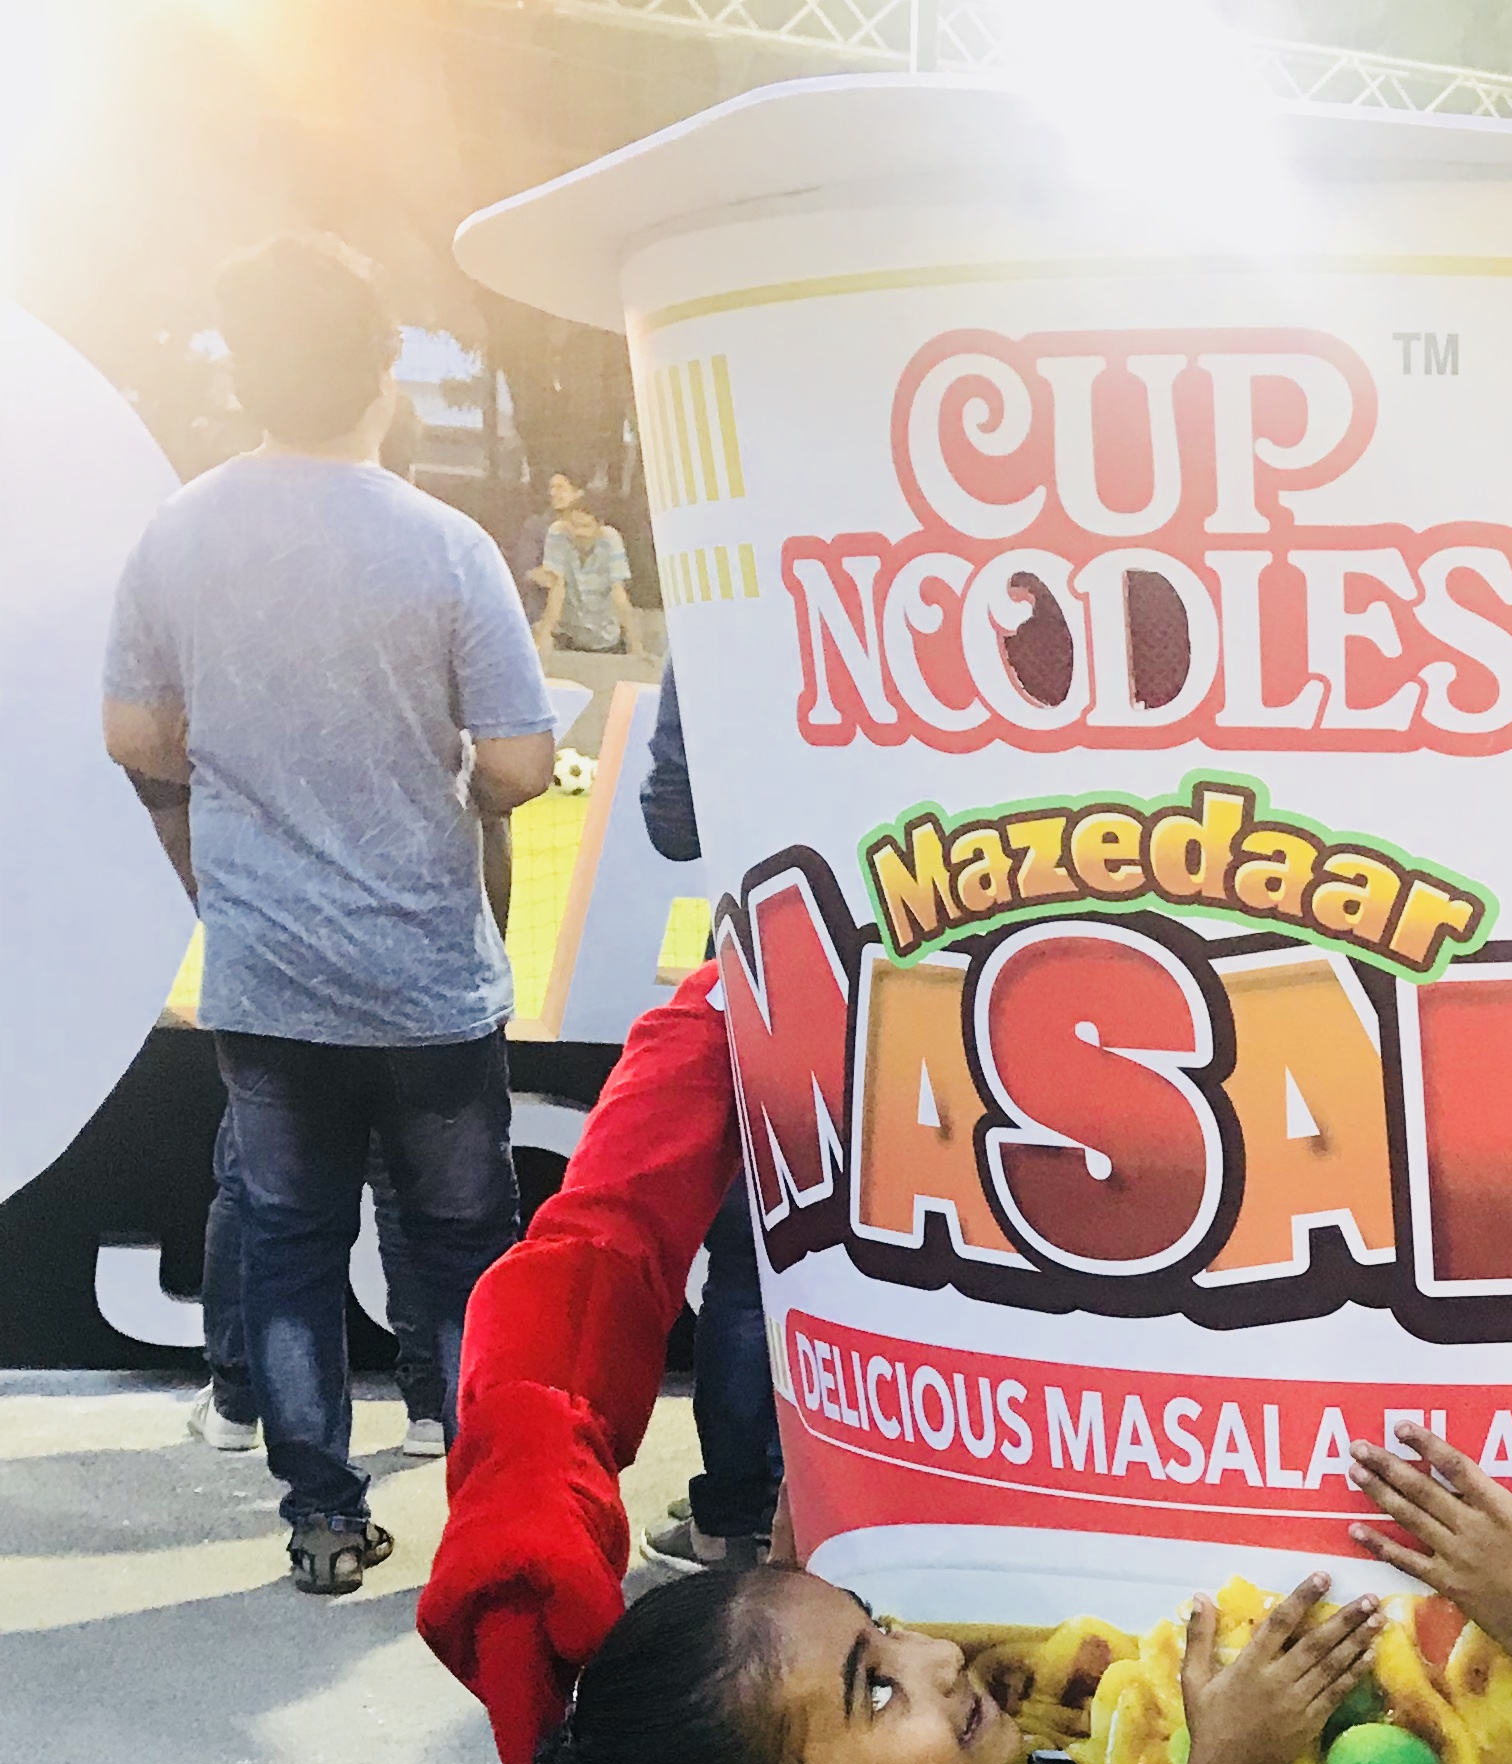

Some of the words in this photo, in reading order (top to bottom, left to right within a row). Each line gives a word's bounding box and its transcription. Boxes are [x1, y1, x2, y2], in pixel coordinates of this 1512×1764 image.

[902, 348, 1358, 540] CUP
[1392, 333, 1460, 376] TM
[868, 787, 1476, 968] Mazedaar
[793, 1330, 1035, 1466] DELICIOUS
[1044, 1384, 1363, 1492] MASALA
